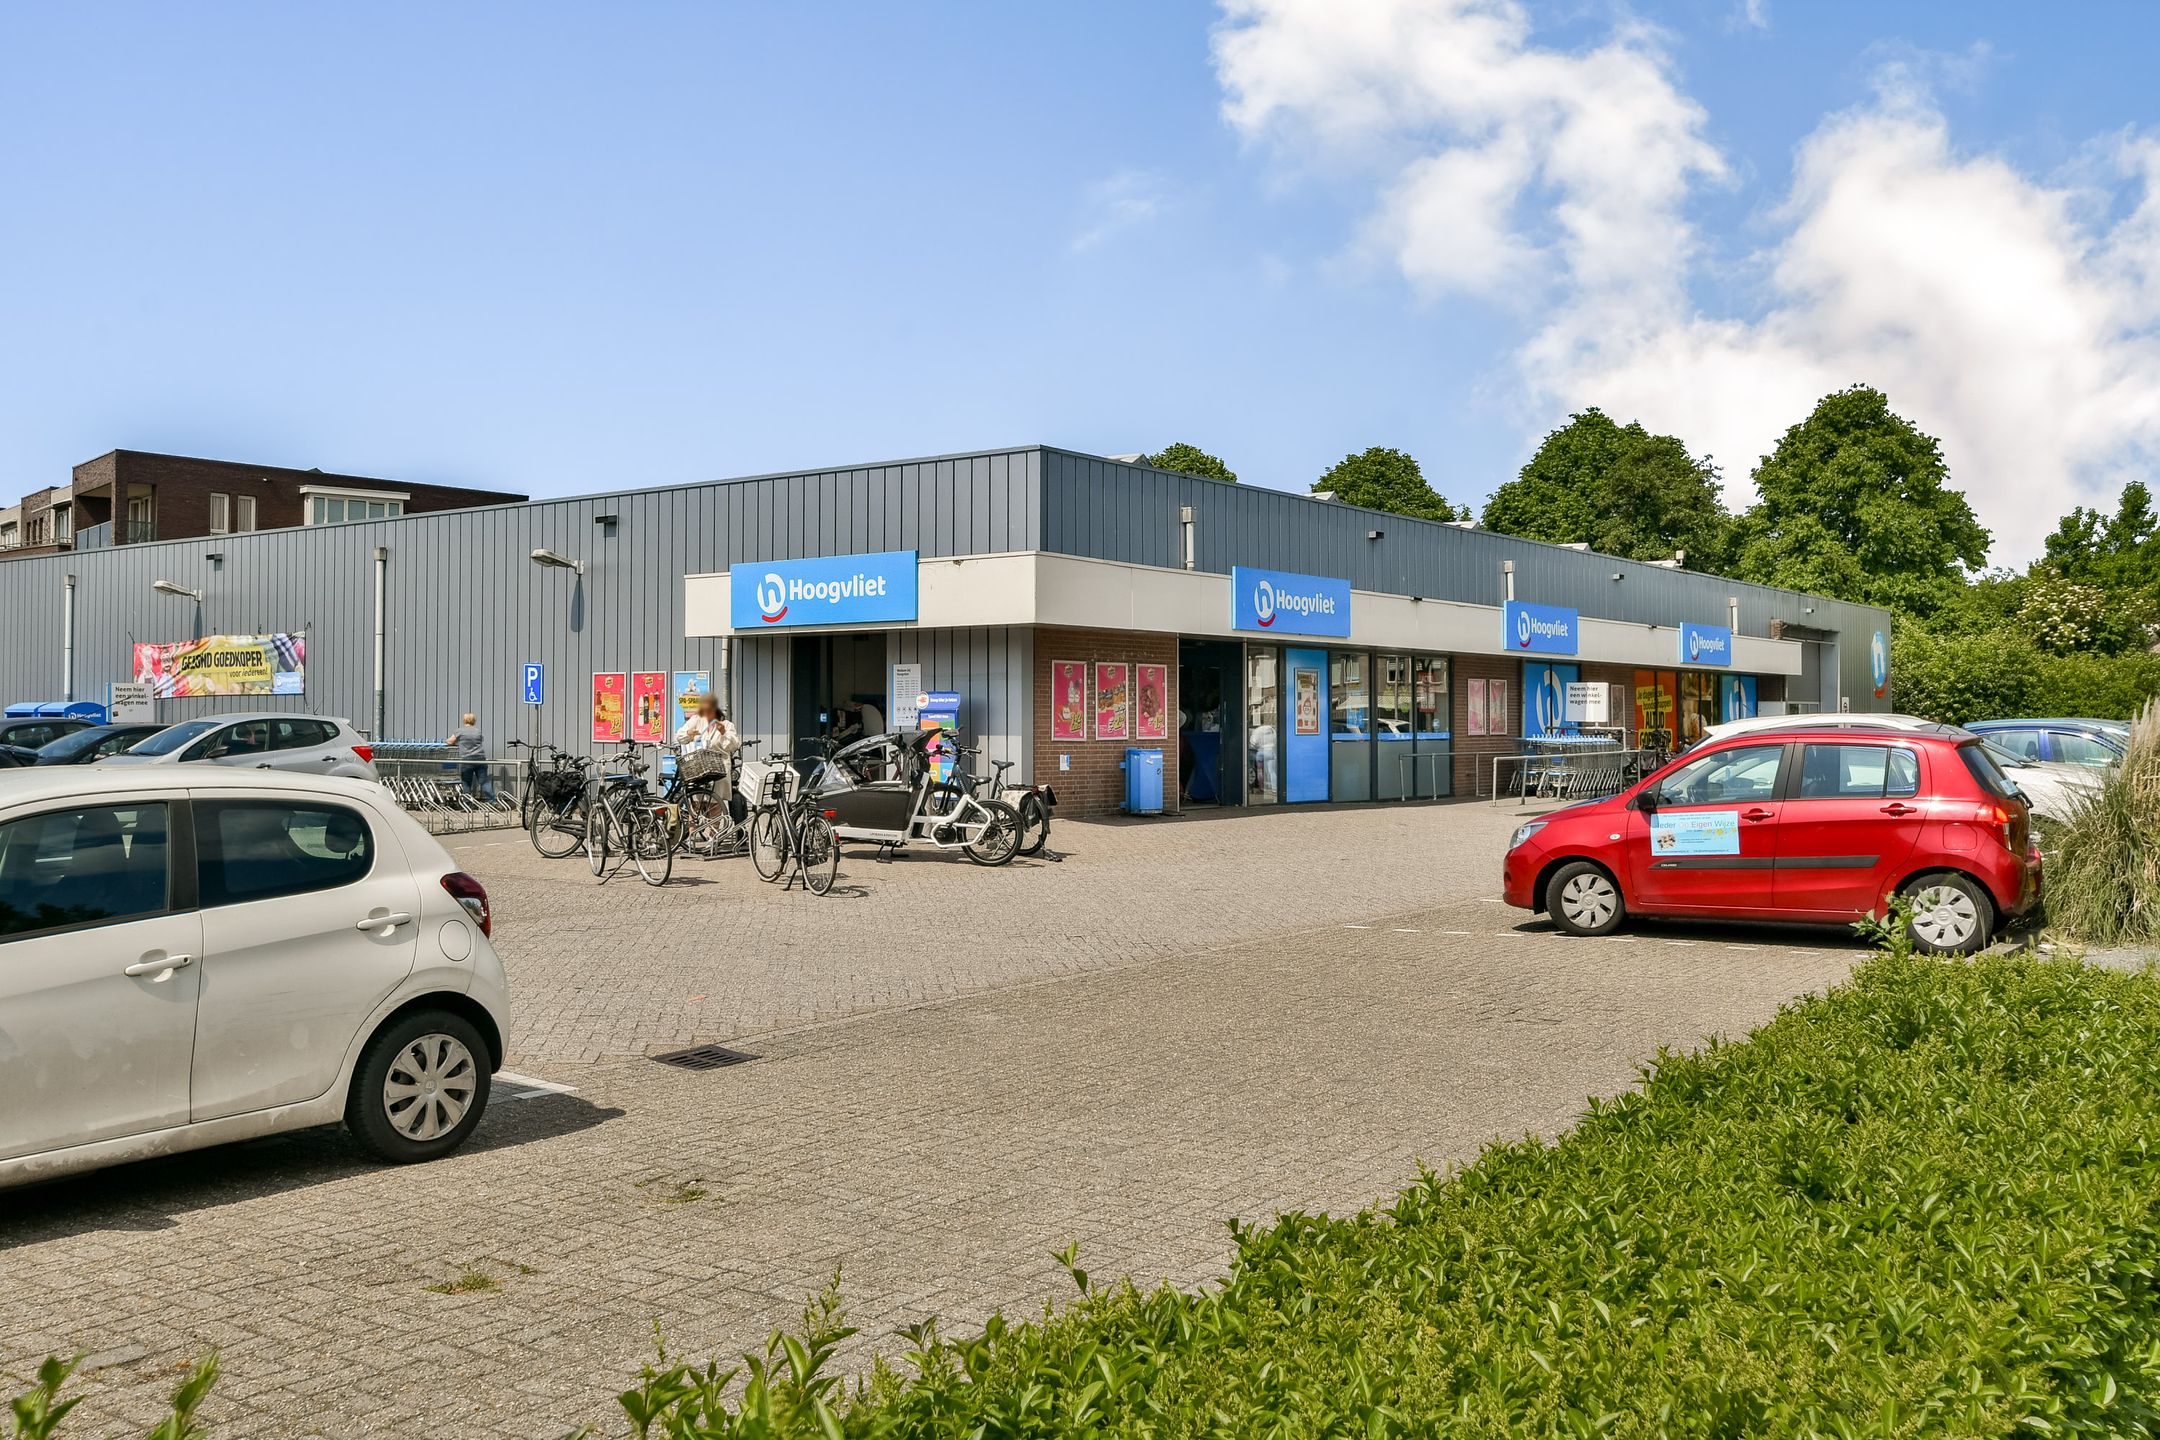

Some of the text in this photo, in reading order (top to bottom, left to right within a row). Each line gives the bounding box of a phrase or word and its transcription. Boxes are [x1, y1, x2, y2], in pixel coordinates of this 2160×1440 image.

[789, 573, 886, 604] Hoogvliet
[1276, 589, 1335, 616] Hoogvliet
[1531, 617, 1568, 638] Hoogvliet
[1699, 635, 1725, 653] Hoogvliet
[213, 650, 263, 668] GOEDKOPER
[229, 667, 268, 678] voor iedereen!
[527, 667, 538, 687] P
[1691, 821, 1712, 829] Eigen
